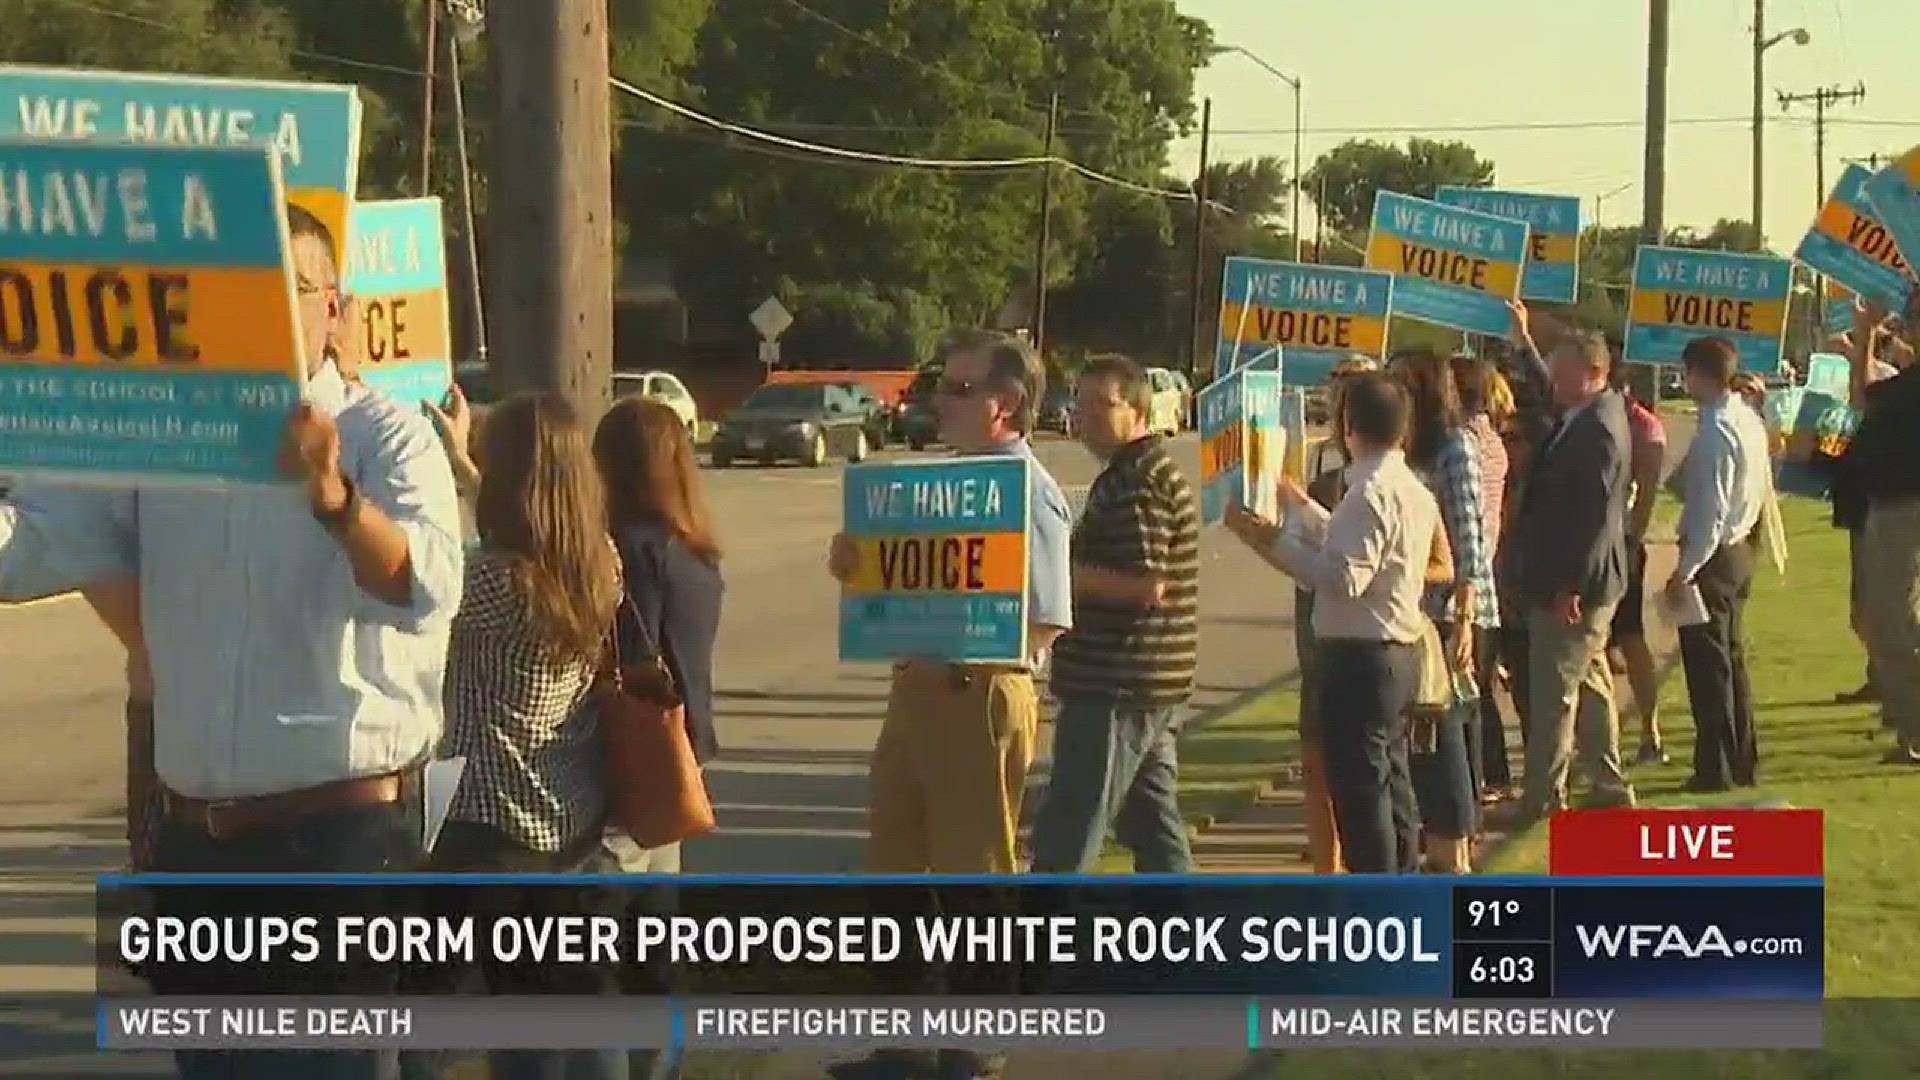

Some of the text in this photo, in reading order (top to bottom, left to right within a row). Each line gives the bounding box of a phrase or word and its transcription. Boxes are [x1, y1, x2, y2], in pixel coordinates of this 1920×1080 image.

[18, 94, 301, 165] WE HAVE A
[0, 162, 218, 244] HAVE A
[1394, 205, 1424, 234] WE
[1433, 213, 1484, 249] HAVE
[1490, 228, 1506, 252] A
[1250, 272, 1280, 297] WE
[1295, 275, 1346, 304] HAVE
[1355, 286, 1367, 305] A
[1402, 242, 1489, 290] VOICE
[1656, 259, 1770, 289] WE HAVE A
[0, 268, 200, 361] OICE
[1257, 308, 1352, 348] VOICE
[1663, 293, 1754, 331] VOICE
[865, 478, 1001, 518] WE HAVE A
[879, 537, 986, 590] VOICE
